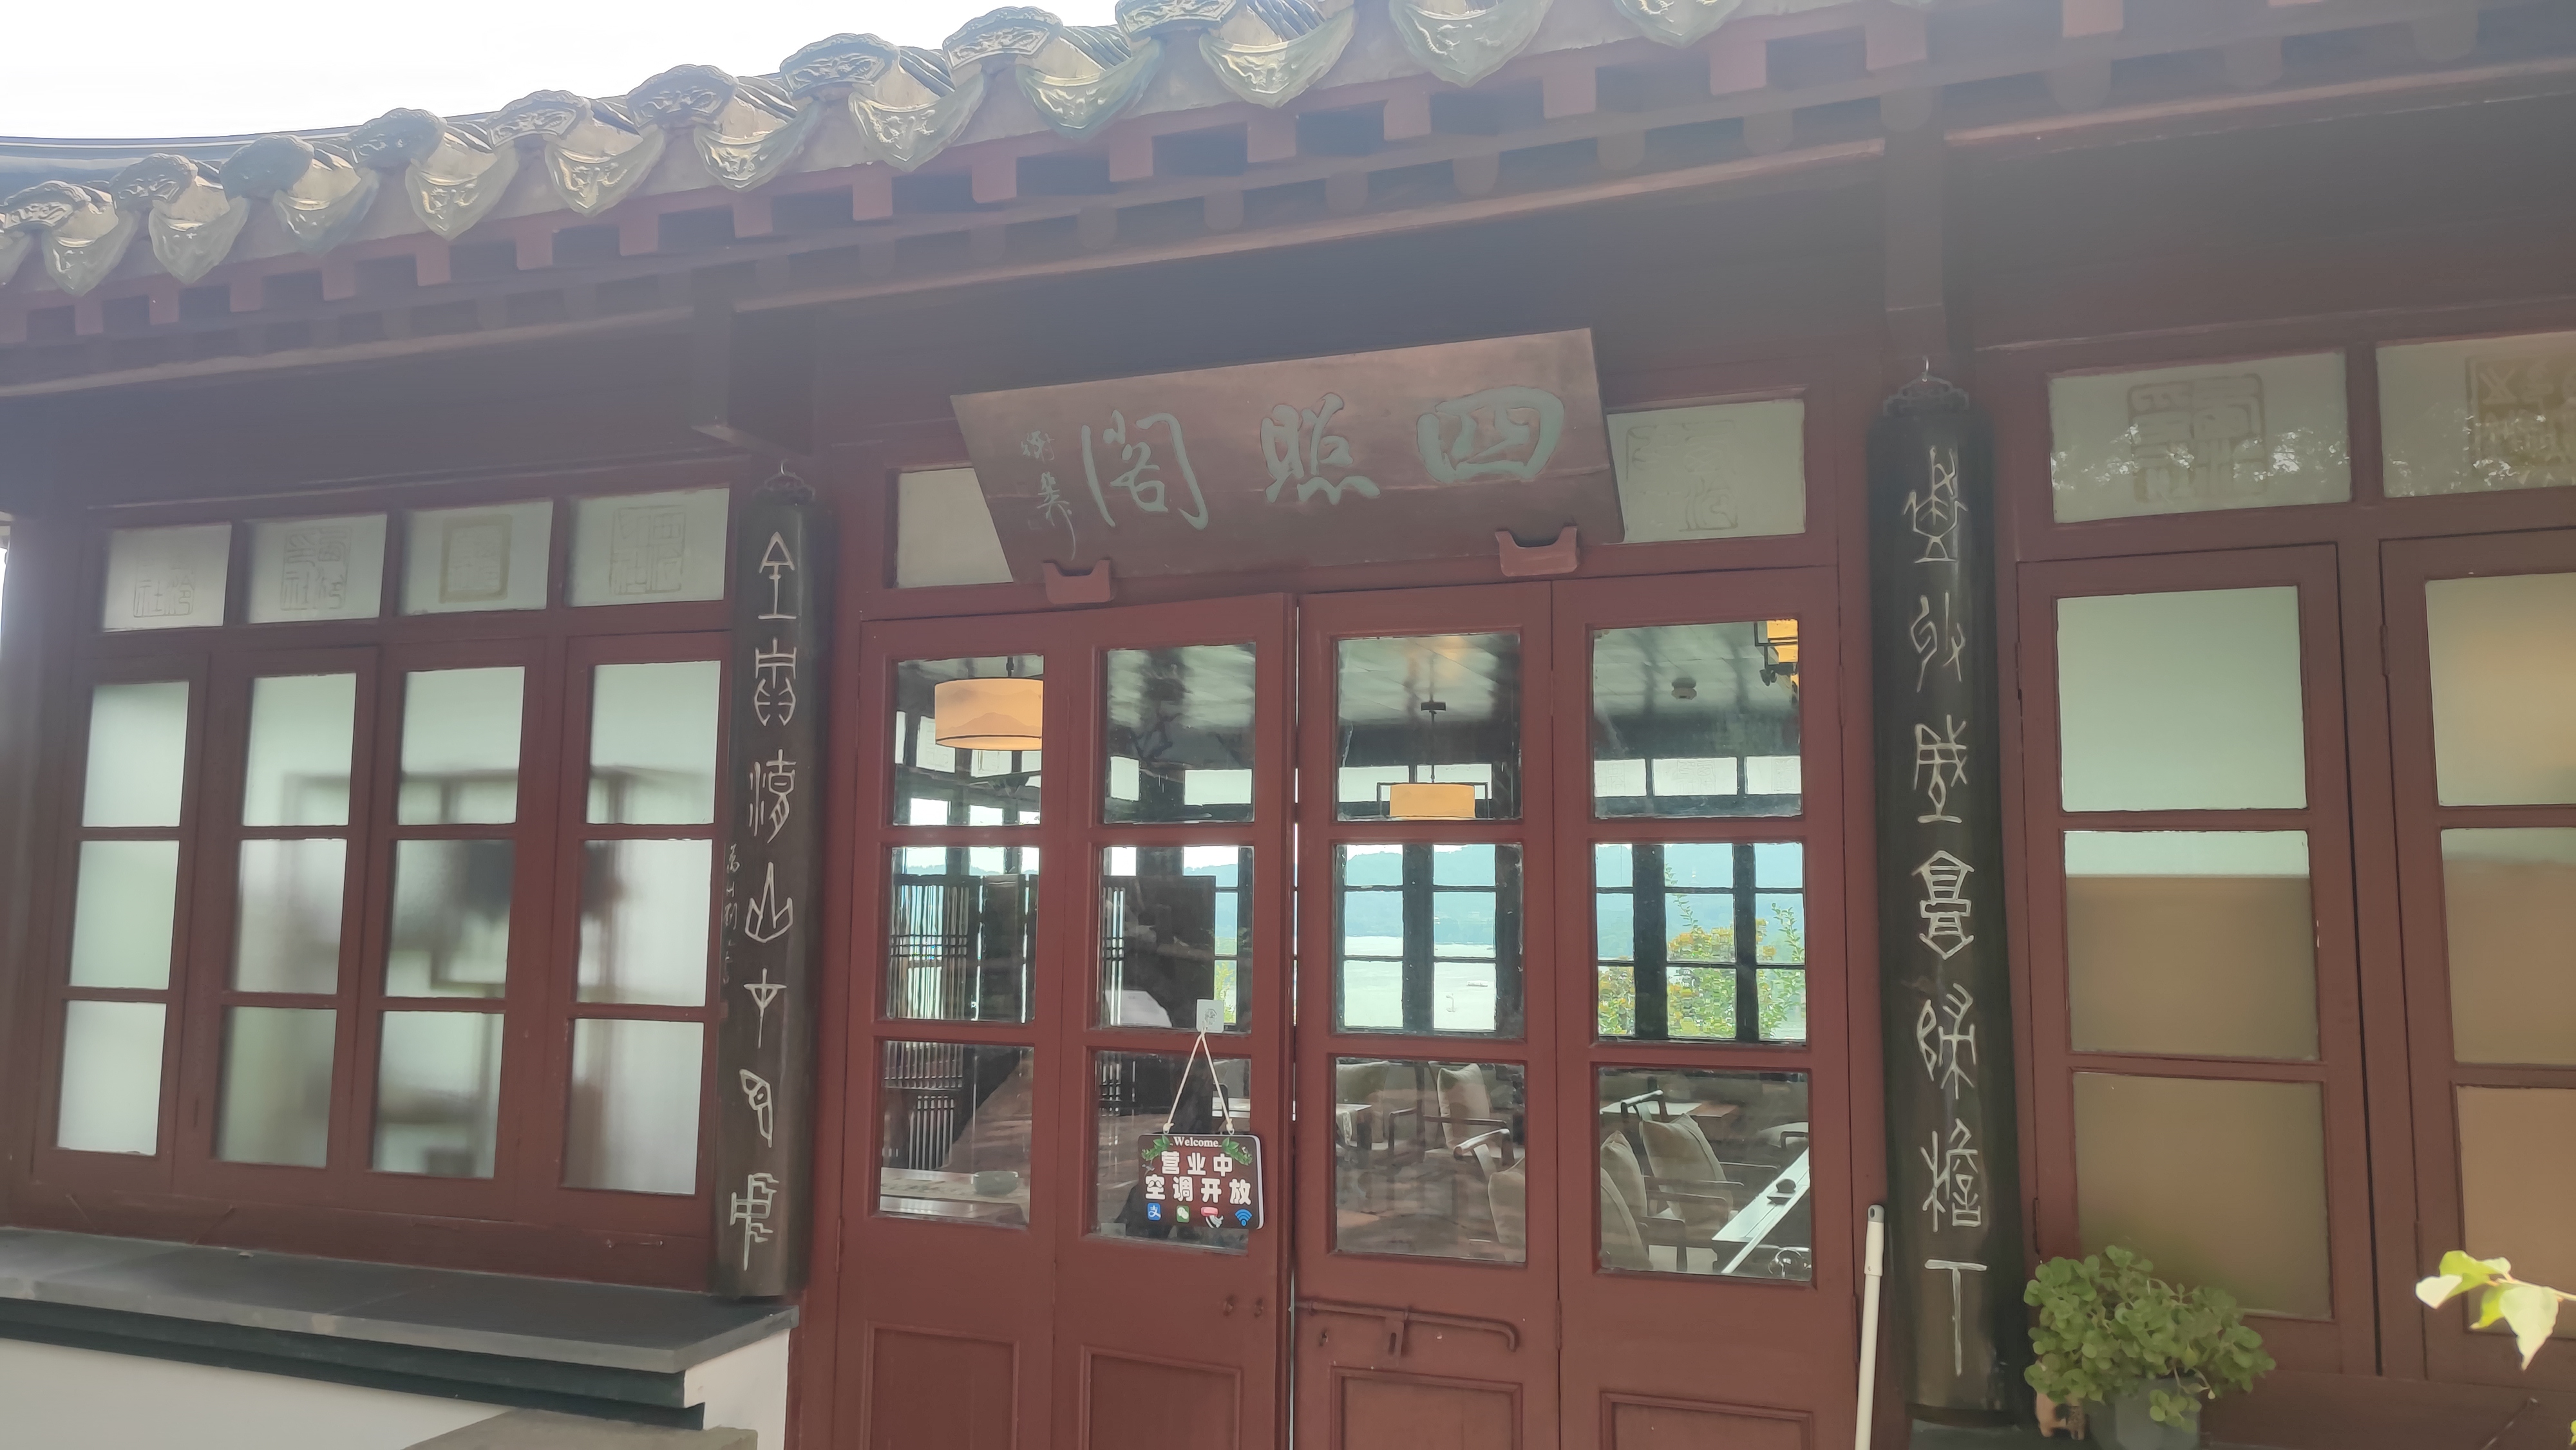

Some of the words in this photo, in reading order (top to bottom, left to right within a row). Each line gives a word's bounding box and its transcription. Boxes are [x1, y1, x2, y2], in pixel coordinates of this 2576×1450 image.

[1161, 1151, 1233, 1176] 营业中
[1145, 1174, 1251, 1205] 空调开放
